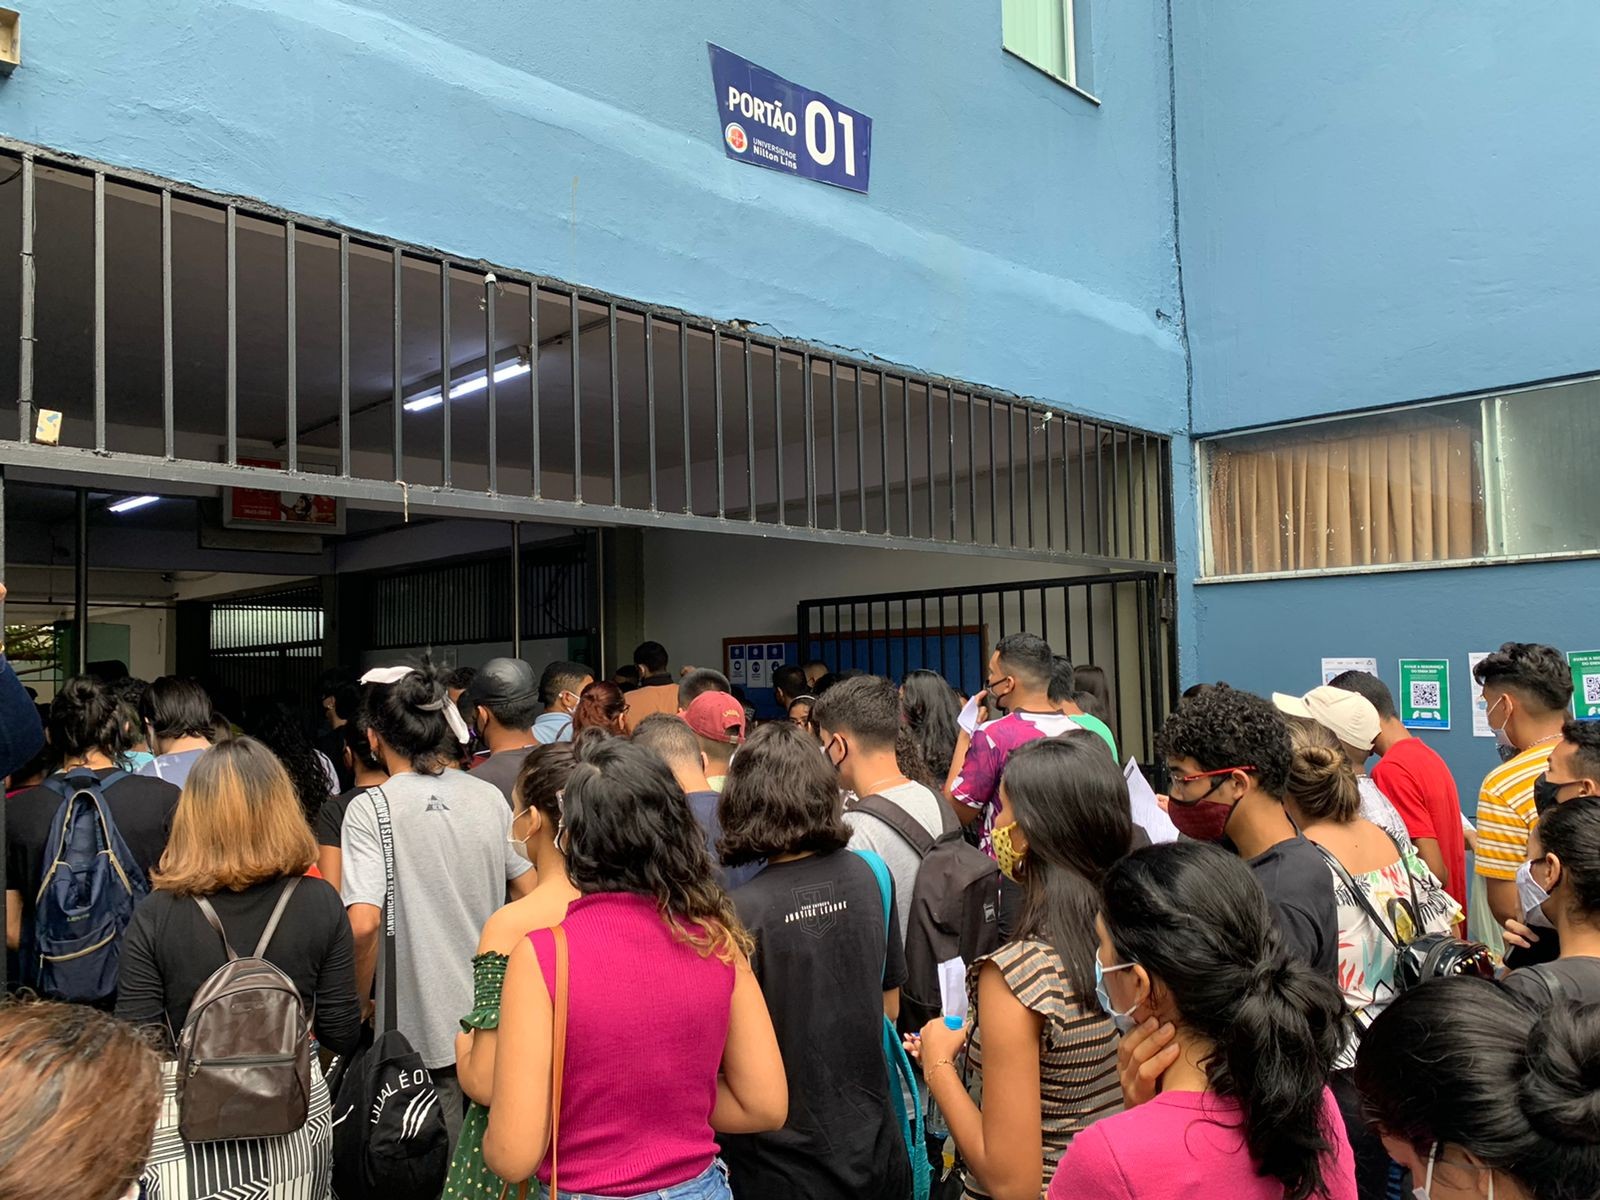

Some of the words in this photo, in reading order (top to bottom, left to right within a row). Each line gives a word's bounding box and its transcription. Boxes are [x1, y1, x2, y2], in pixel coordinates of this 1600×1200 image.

[728, 86, 797, 137] PORTÃO
[804, 99, 856, 177] 01
[753, 137, 797, 161] UNIVERSIDADE
[753, 145, 779, 163] Nilton
[780, 156, 797, 170] Lins
